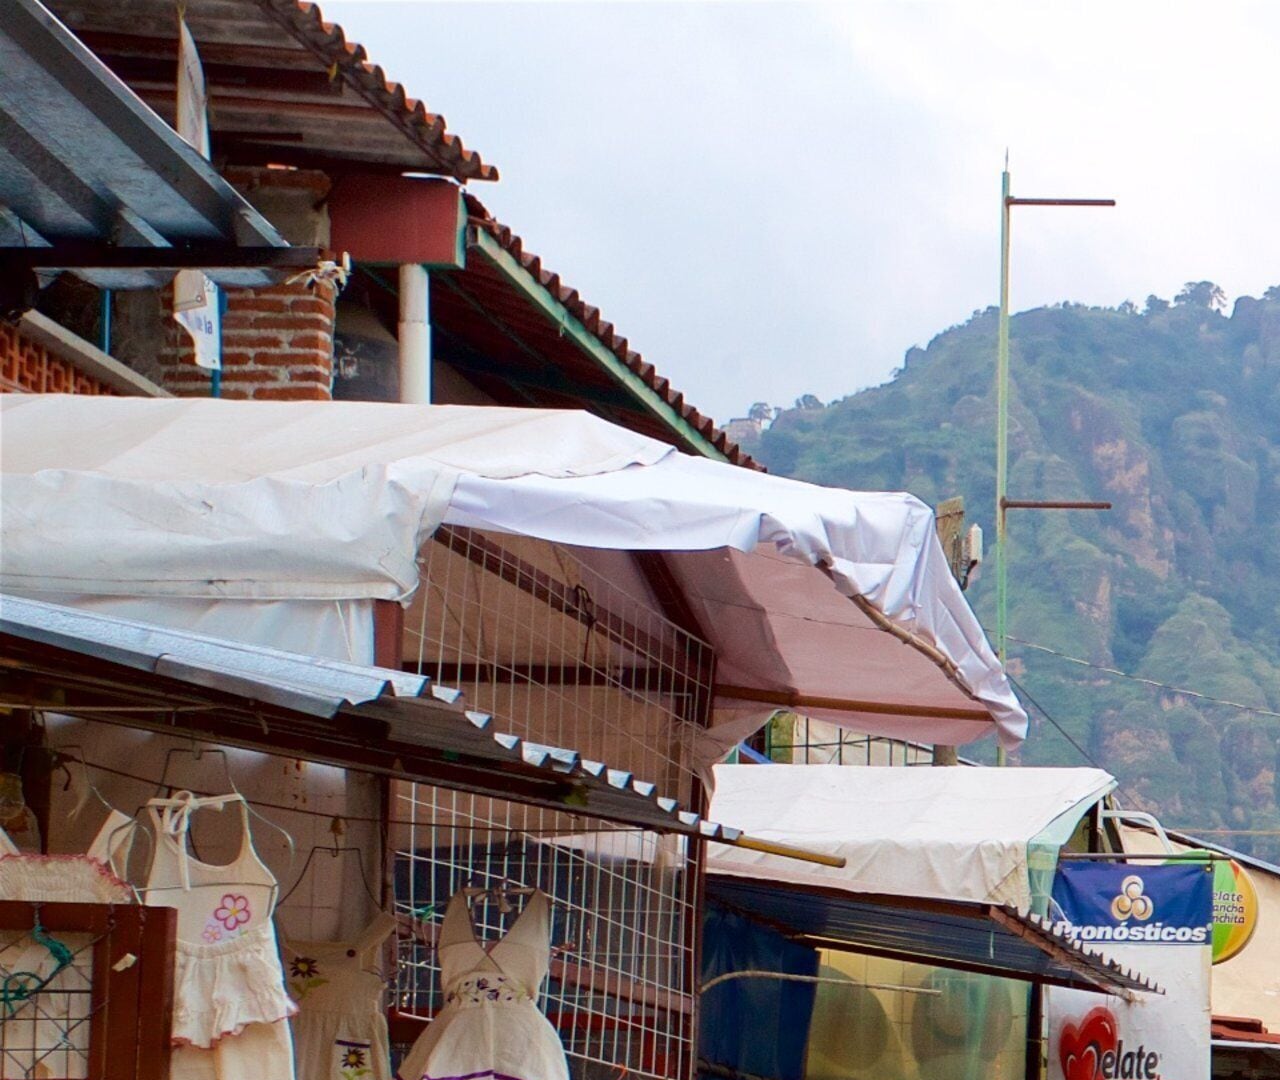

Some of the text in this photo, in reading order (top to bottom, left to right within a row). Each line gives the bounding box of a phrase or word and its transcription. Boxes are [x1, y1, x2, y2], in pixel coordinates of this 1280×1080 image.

[1212, 890, 1243, 902] elate
[1212, 903, 1245, 913] ancha
[1212, 913, 1245, 924] nchita
[1053, 921, 1207, 942] Pronósticos
